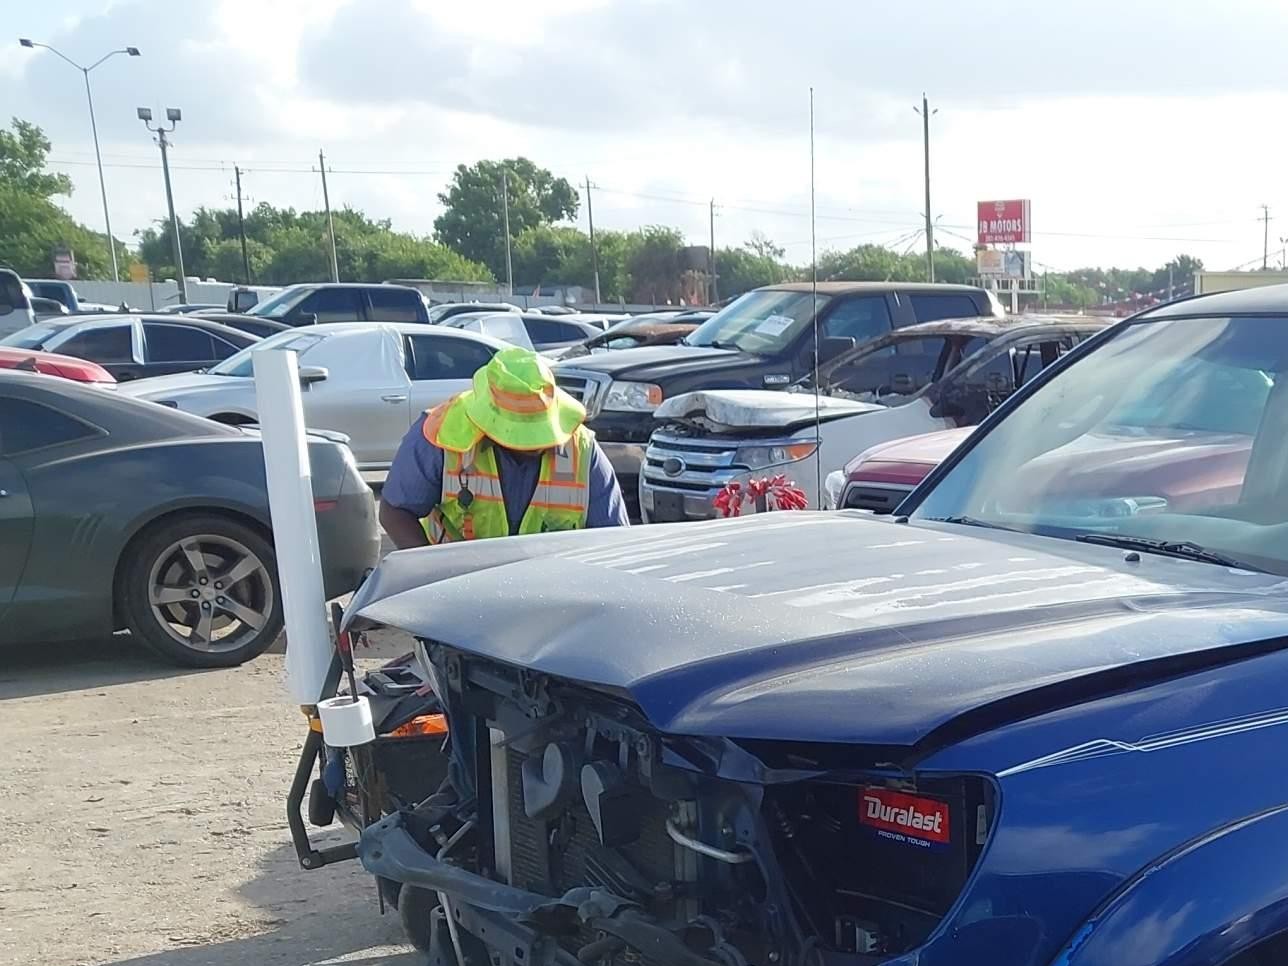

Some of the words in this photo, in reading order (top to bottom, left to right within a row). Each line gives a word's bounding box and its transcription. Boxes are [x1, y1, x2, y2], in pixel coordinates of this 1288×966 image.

[989, 218, 1022, 233] MOTORS
[864, 796, 943, 834] Duralast
[878, 830, 906, 843] PROVEN
[907, 837, 931, 848] TOUGH
